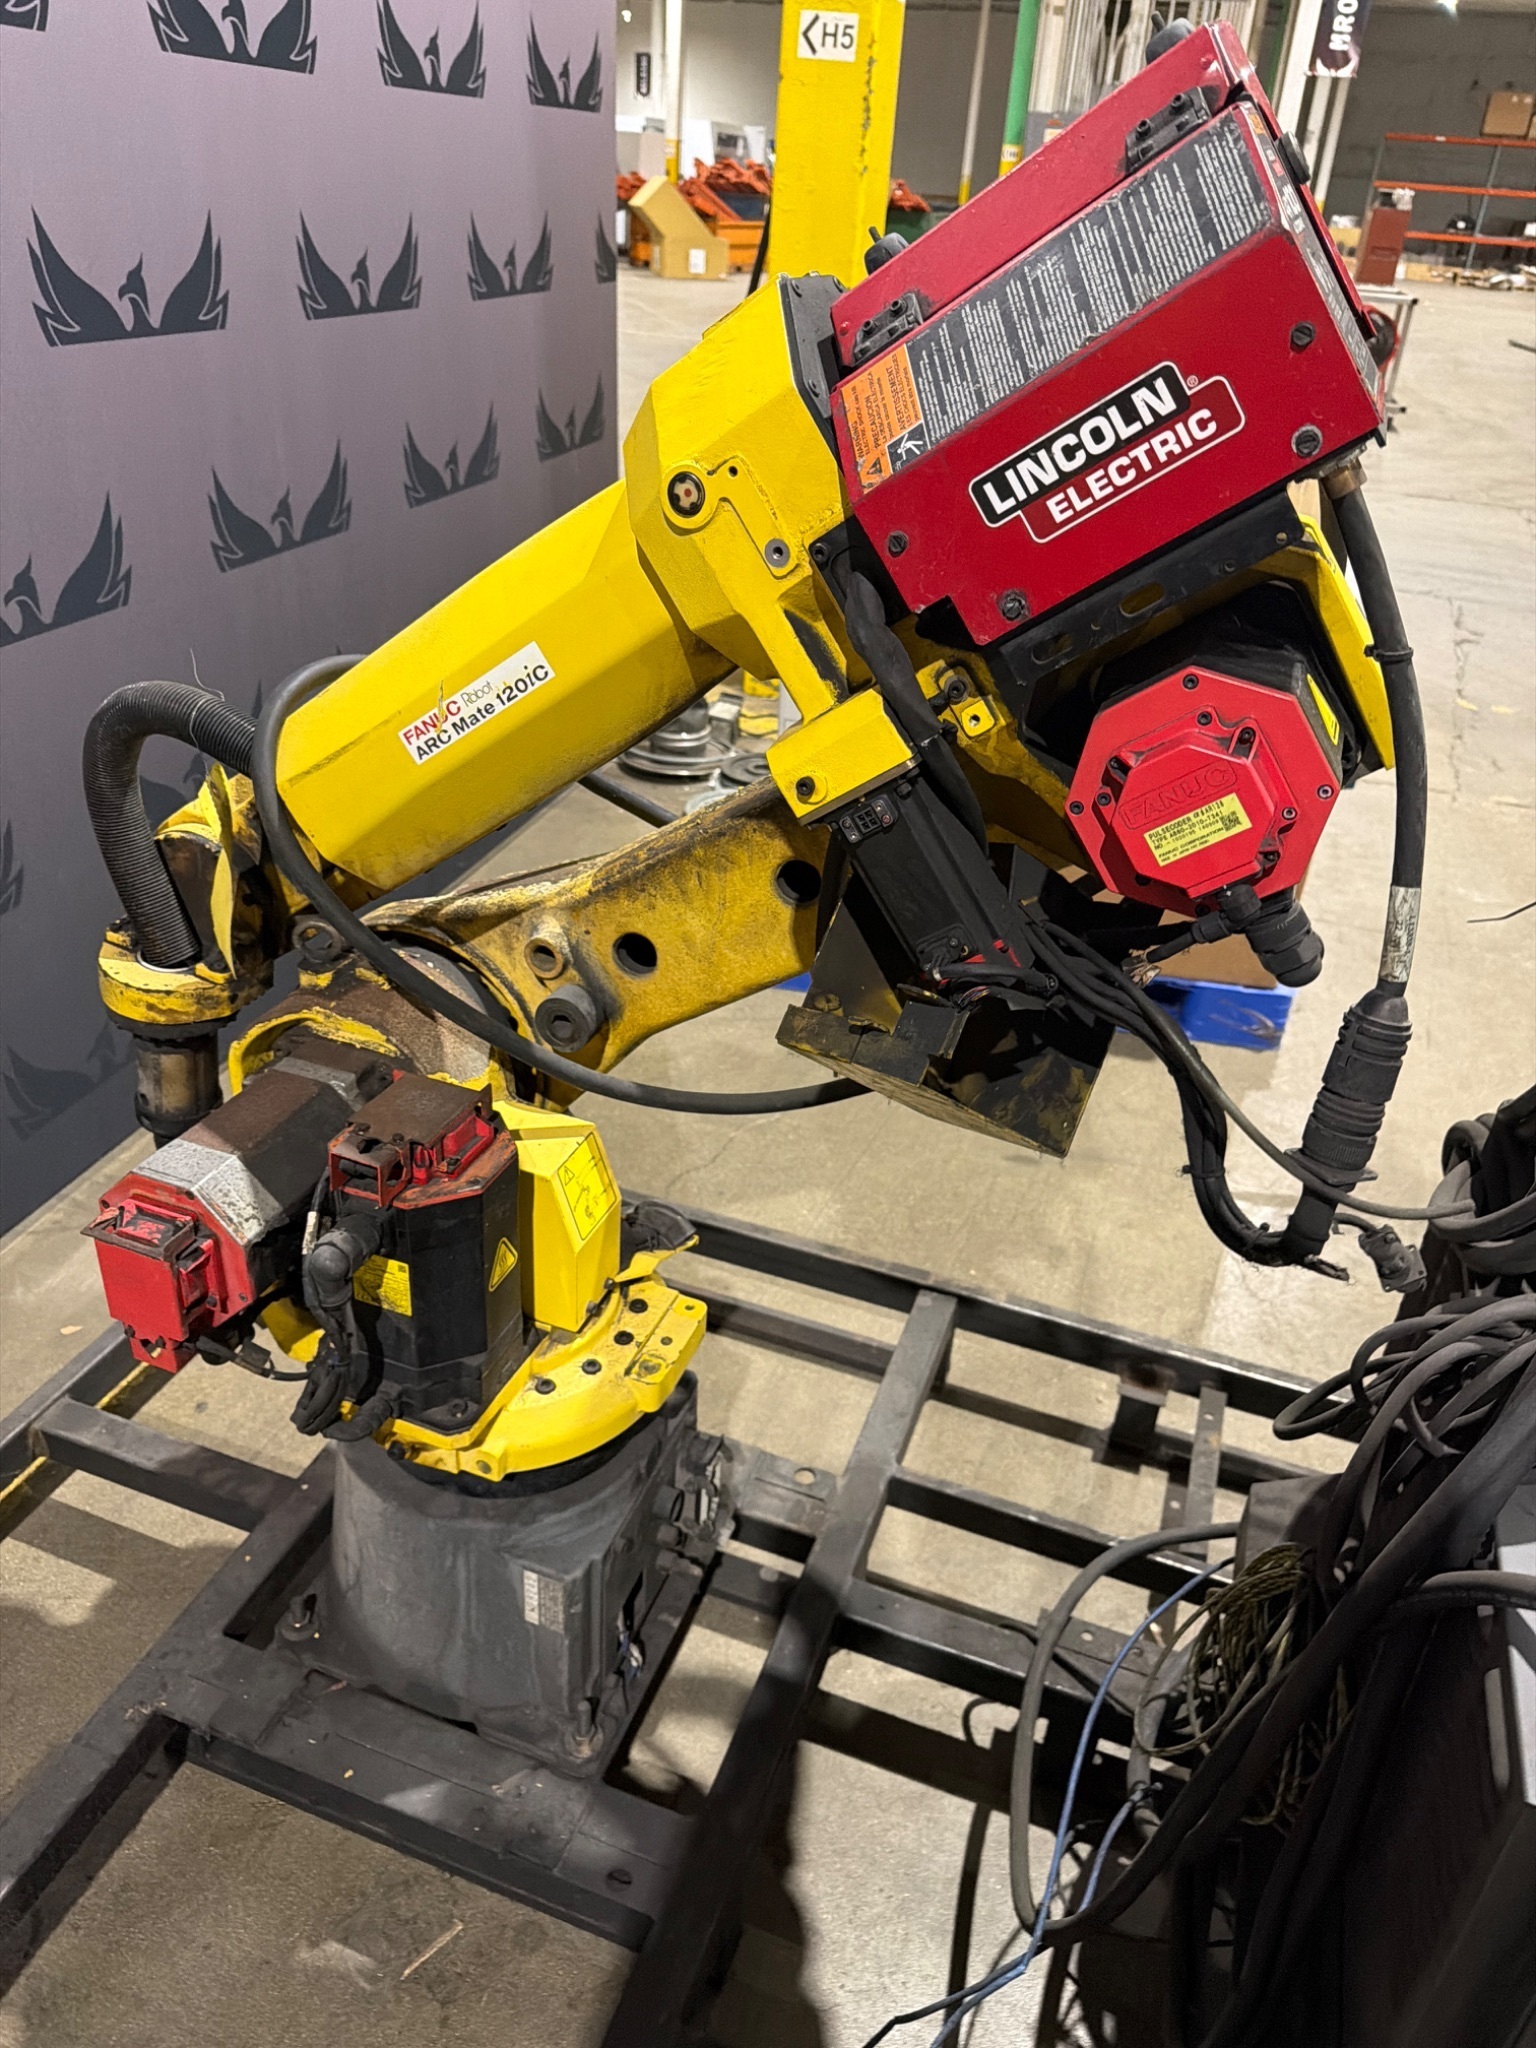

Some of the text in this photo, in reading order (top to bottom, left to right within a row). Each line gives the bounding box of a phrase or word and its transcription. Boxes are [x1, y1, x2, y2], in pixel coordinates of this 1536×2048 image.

[821, 22, 854, 50] H5
[886, 365, 906, 430] AVERTISSEMENT
[851, 420, 864, 458] WARNING
[983, 377, 1177, 514] LINCOLN
[1046, 408, 1217, 524] ELECTRIC
[416, 664, 549, 760] ARC Mate 120iC
[461, 680, 493, 708] Robot
[1124, 769, 1230, 823] FANUC
[1148, 815, 1192, 840] PULSECODER
[1151, 834, 1168, 846] TYPE
